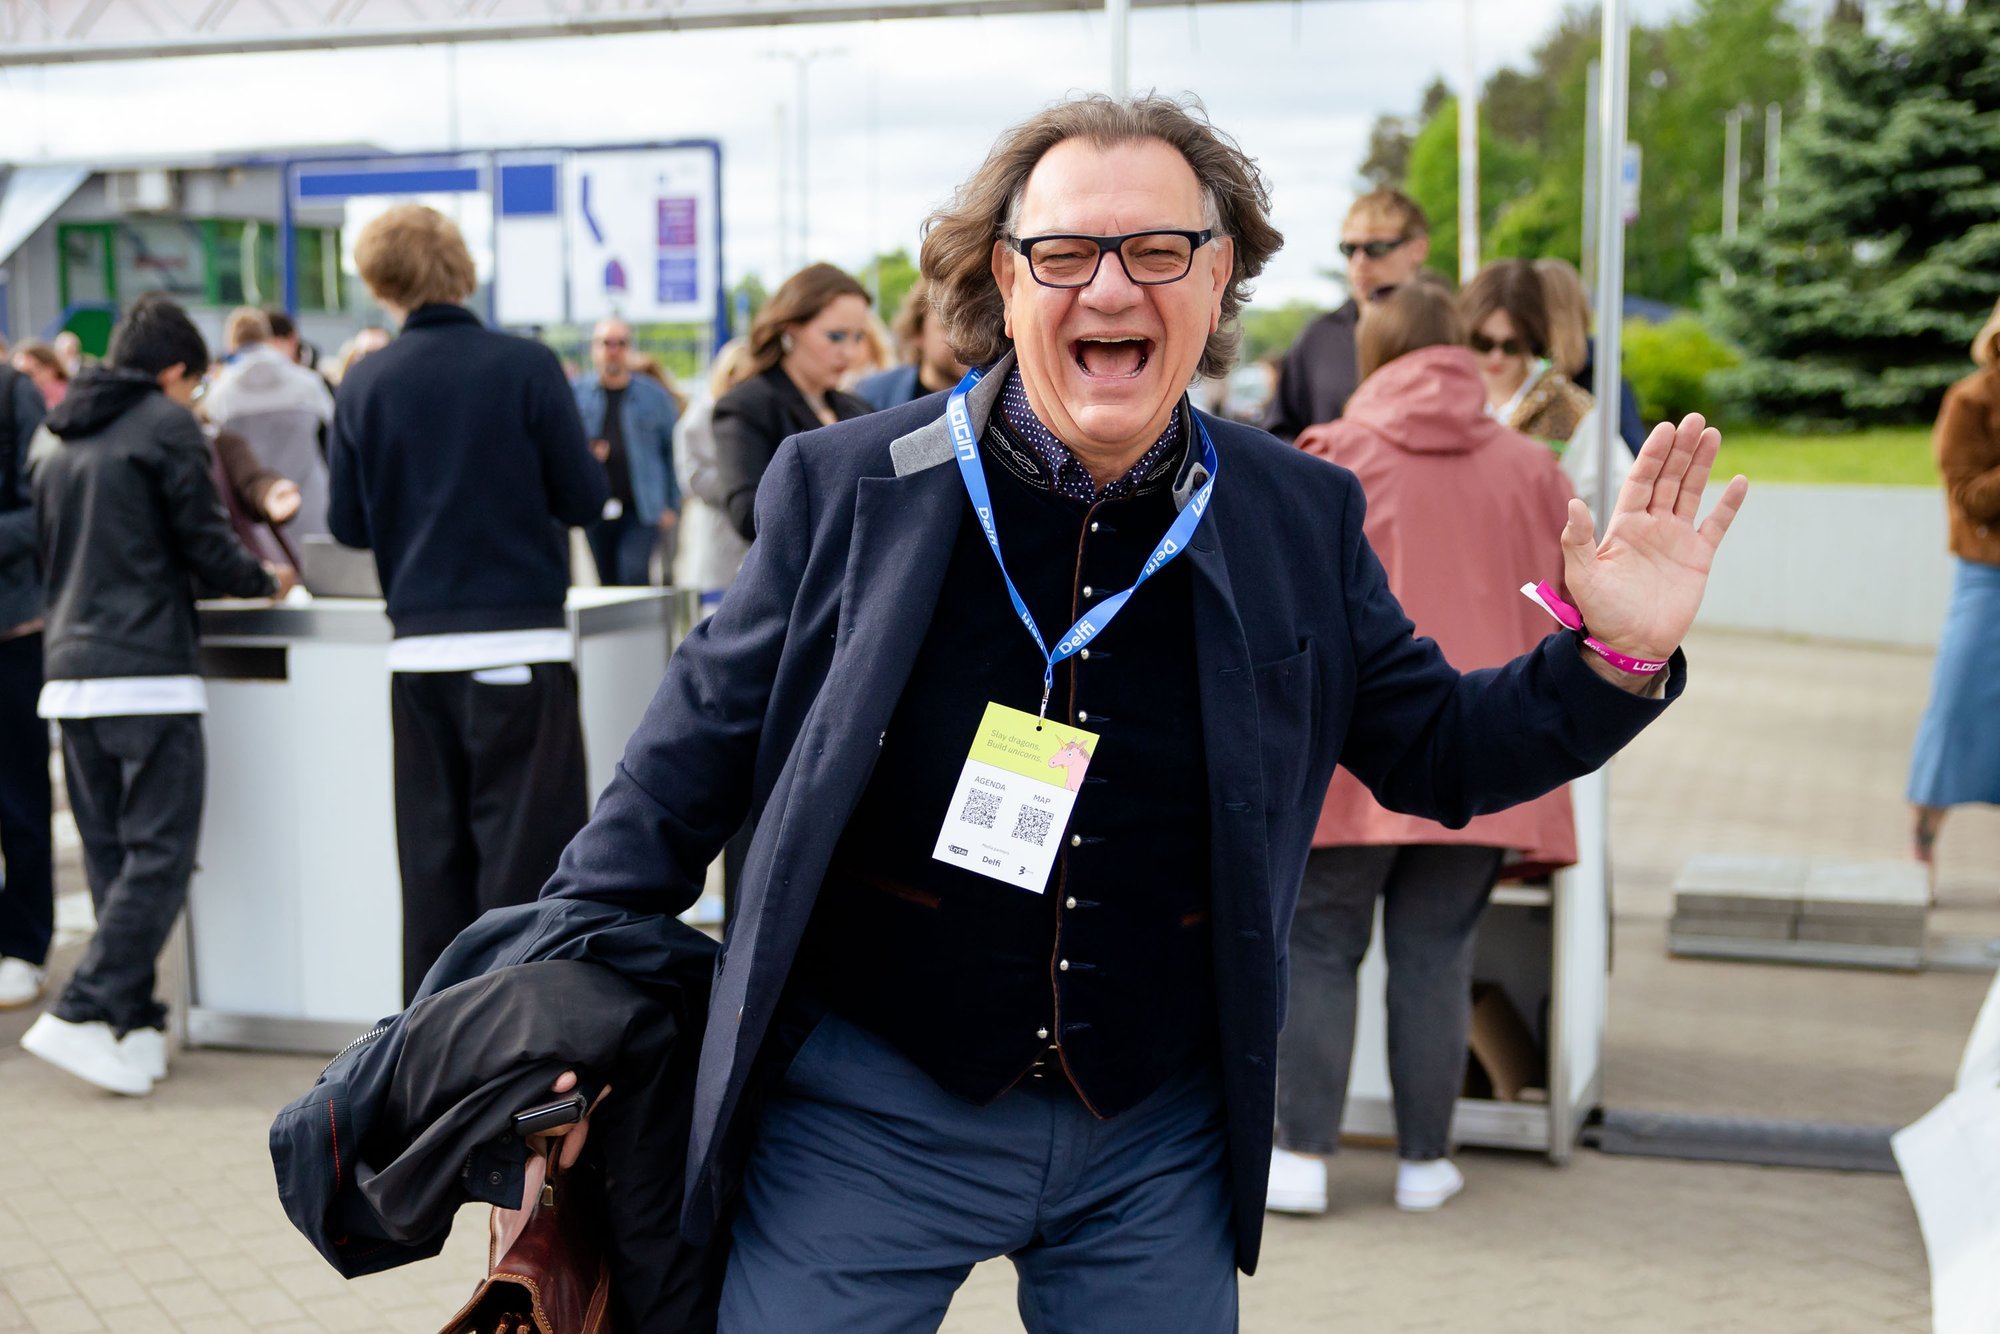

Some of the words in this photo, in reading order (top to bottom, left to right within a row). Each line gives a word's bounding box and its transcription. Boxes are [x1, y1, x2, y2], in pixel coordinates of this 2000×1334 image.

[978, 507, 997, 545] Delfi
[1145, 538, 1178, 576] Delfi
[1059, 620, 1096, 656] Delfi
[991, 729, 1008, 742] Slay
[987, 739, 1007, 752] Build
[1008, 747, 1042, 763] unicorns.
[974, 776, 1006, 791] AGENDA
[1033, 794, 1051, 804] MAP
[982, 856, 1001, 867] Delfi
